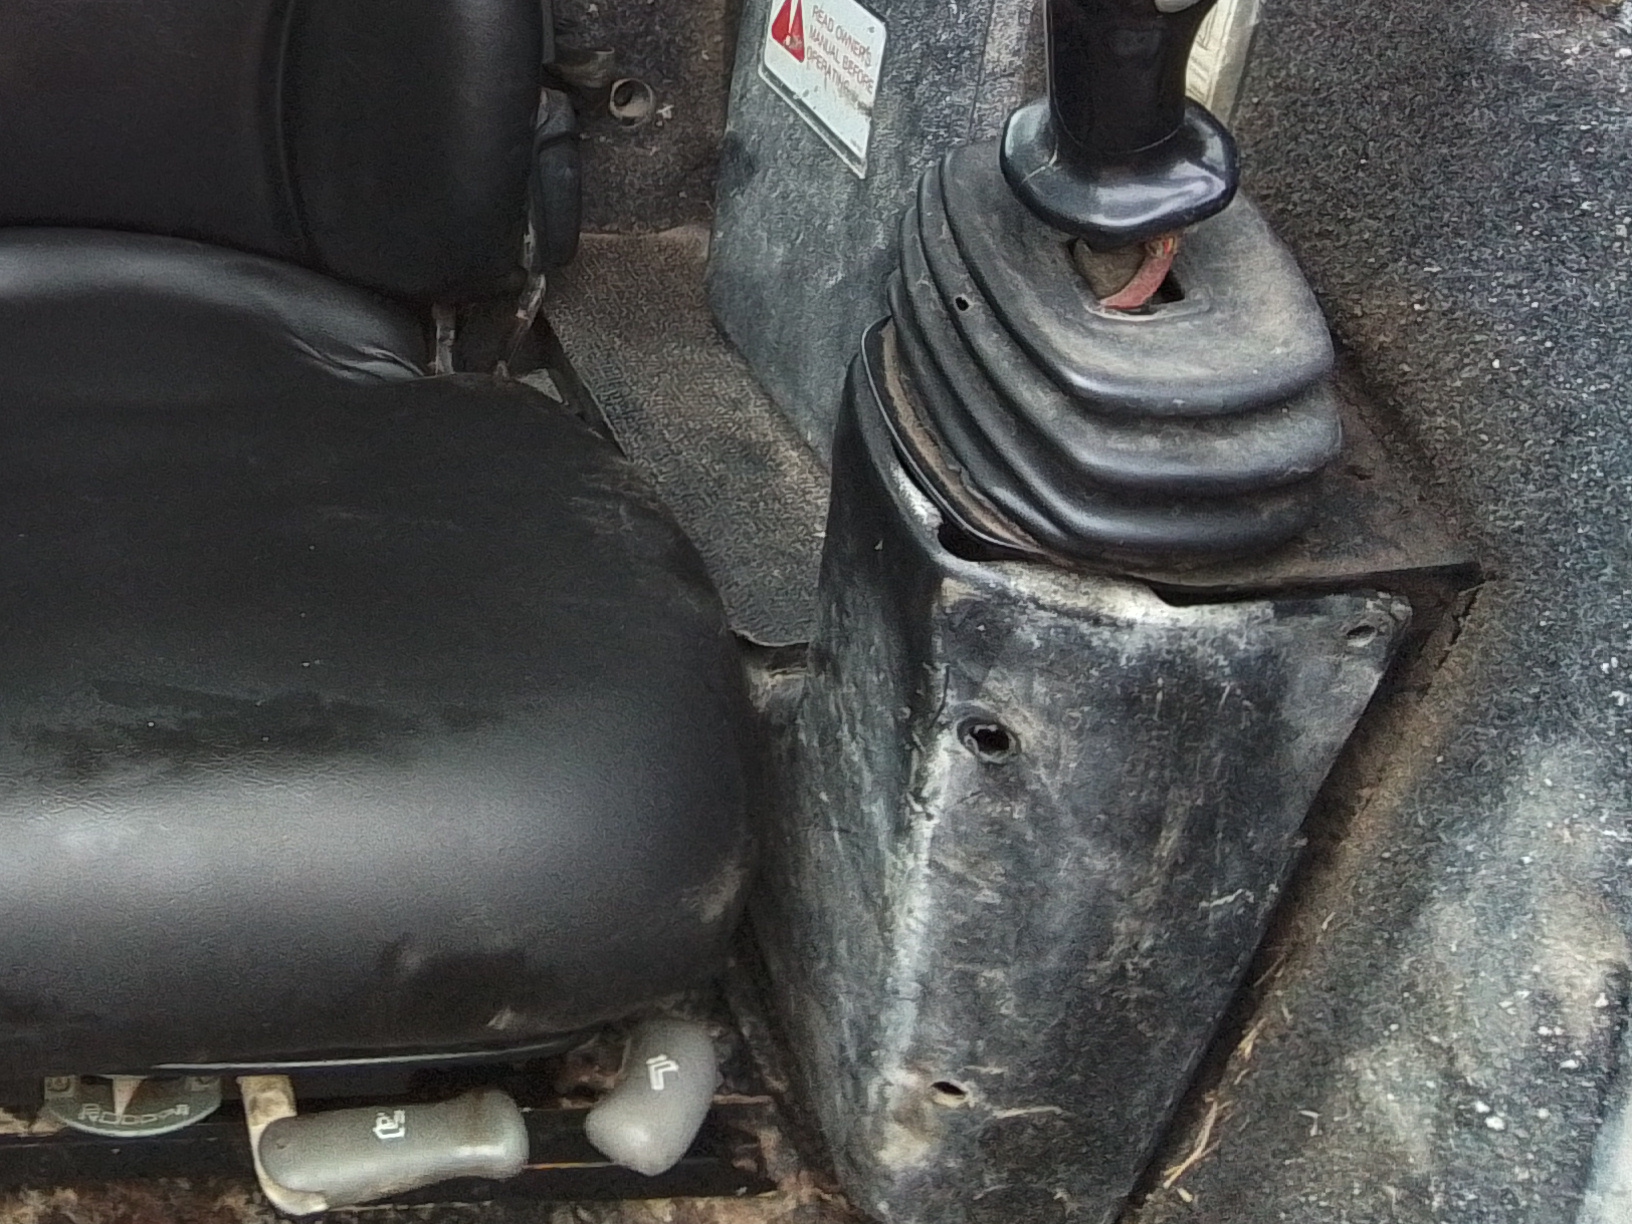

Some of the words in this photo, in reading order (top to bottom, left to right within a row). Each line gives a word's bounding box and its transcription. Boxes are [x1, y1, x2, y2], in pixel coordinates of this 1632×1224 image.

[808, 24, 840, 65] MANUAL
[842, 55, 874, 95] BEFORE
[812, 5, 835, 33] READ
[835, 25, 872, 67] OWNER'S
